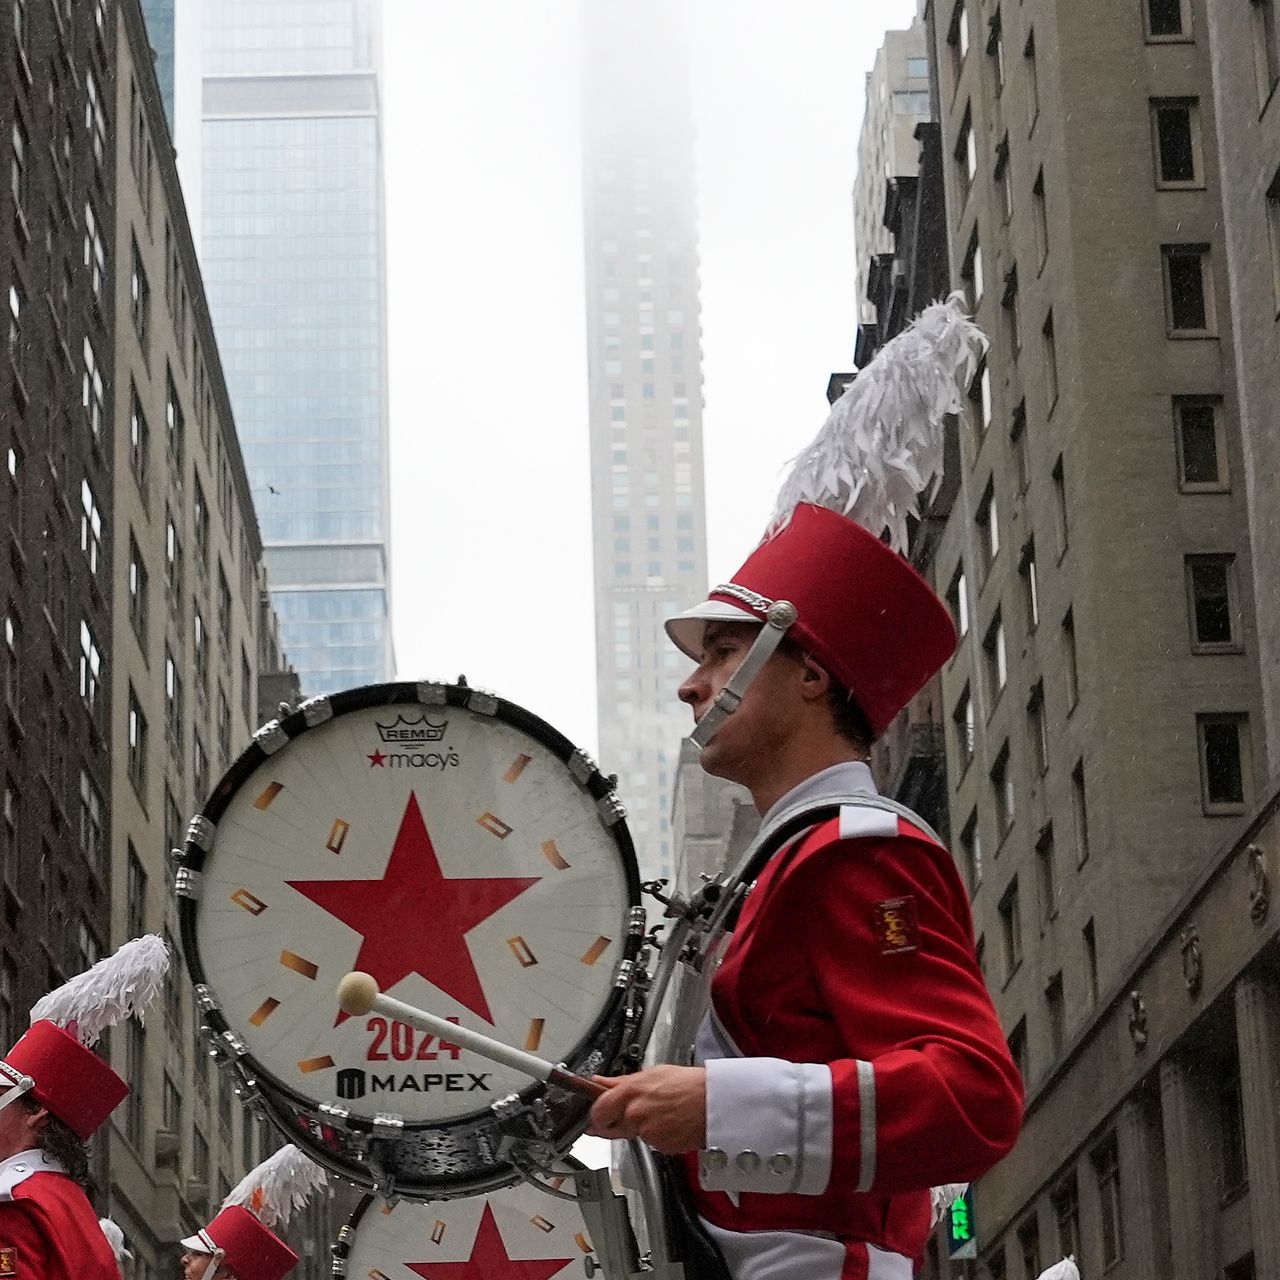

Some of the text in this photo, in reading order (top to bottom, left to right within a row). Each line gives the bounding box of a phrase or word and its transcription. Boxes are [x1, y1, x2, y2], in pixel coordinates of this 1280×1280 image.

[387, 729, 438, 739] REMO
[366, 1016, 462, 1061] 2024
[371, 1073, 492, 1093] MAPEX
